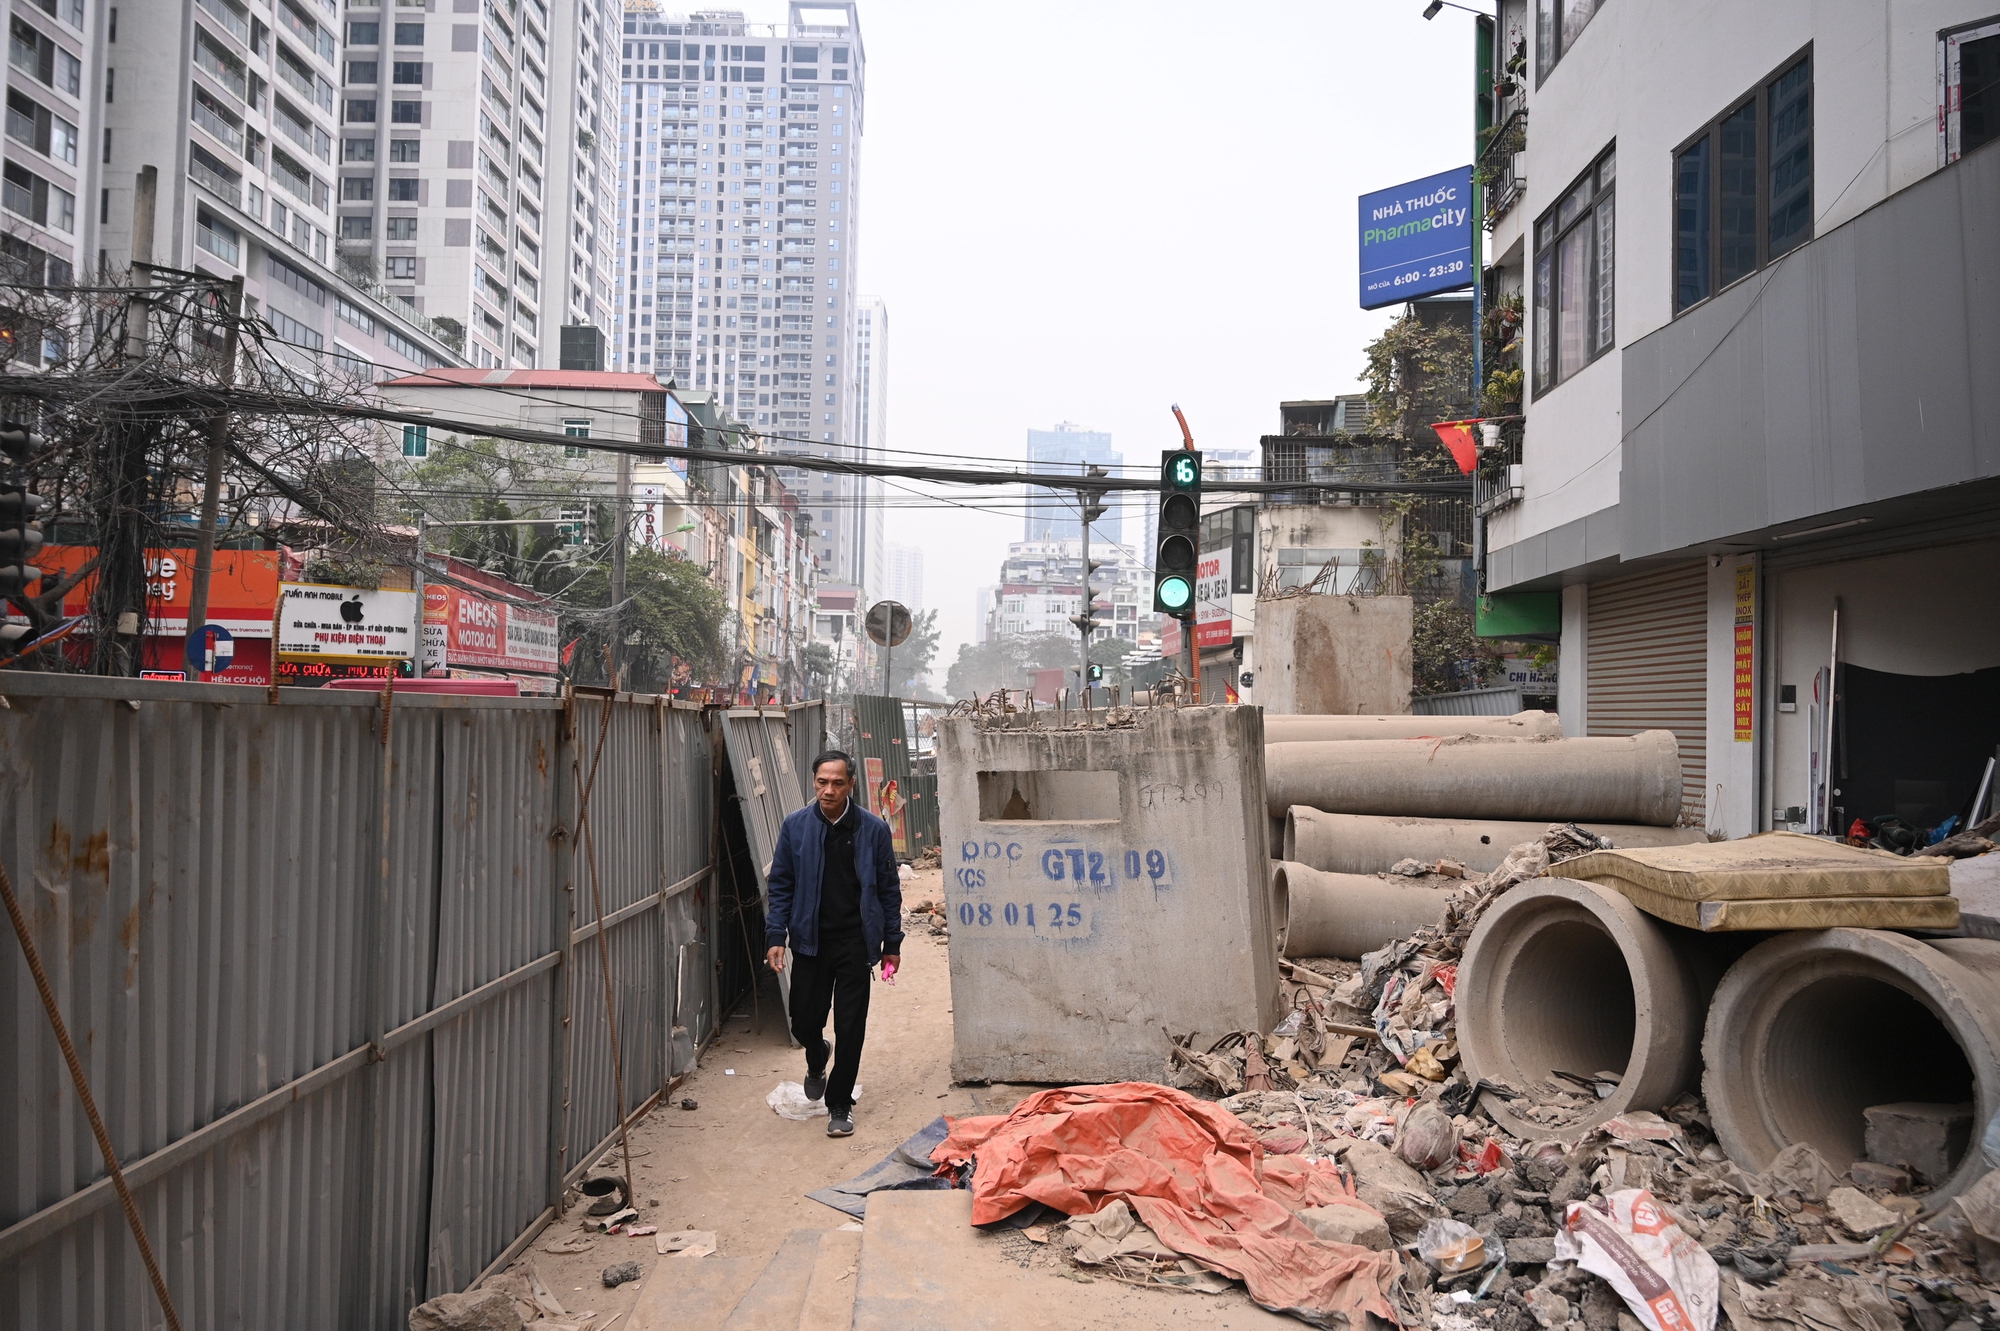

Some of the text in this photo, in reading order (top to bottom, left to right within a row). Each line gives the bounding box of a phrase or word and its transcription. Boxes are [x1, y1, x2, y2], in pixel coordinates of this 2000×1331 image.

[1373, 186, 1457, 221] NHÀ THUỐC
[1364, 207, 1466, 247] Pharmacity
[1367, 283, 1378, 291] MỞ
[1394, 271, 1420, 287] 6:00
[1429, 260, 1463, 278] 23:30
[1176, 459, 1194, 482] 16
[1214, 580, 1221, 599] XE
[1738, 576, 1750, 590] SẮT
[1737, 591, 1752, 603] THÉP
[459, 598, 498, 630] ENEOS
[1736, 605, 1752, 616] INOX
[424, 626, 443, 636] SỬA
[315, 632, 386, 647] PHỤ KIỆN ĐIỆN THOẠI
[458, 629, 485, 647] MOTOR
[486, 633, 497, 649] OIL
[1735, 645, 1752, 655] KÍNH
[211, 675, 265, 686] HÊM CƠ HỘI
[1509, 672, 1527, 685] CHỊ
[1735, 700, 1751, 712] SẮT
[1736, 716, 1750, 726] INOX
